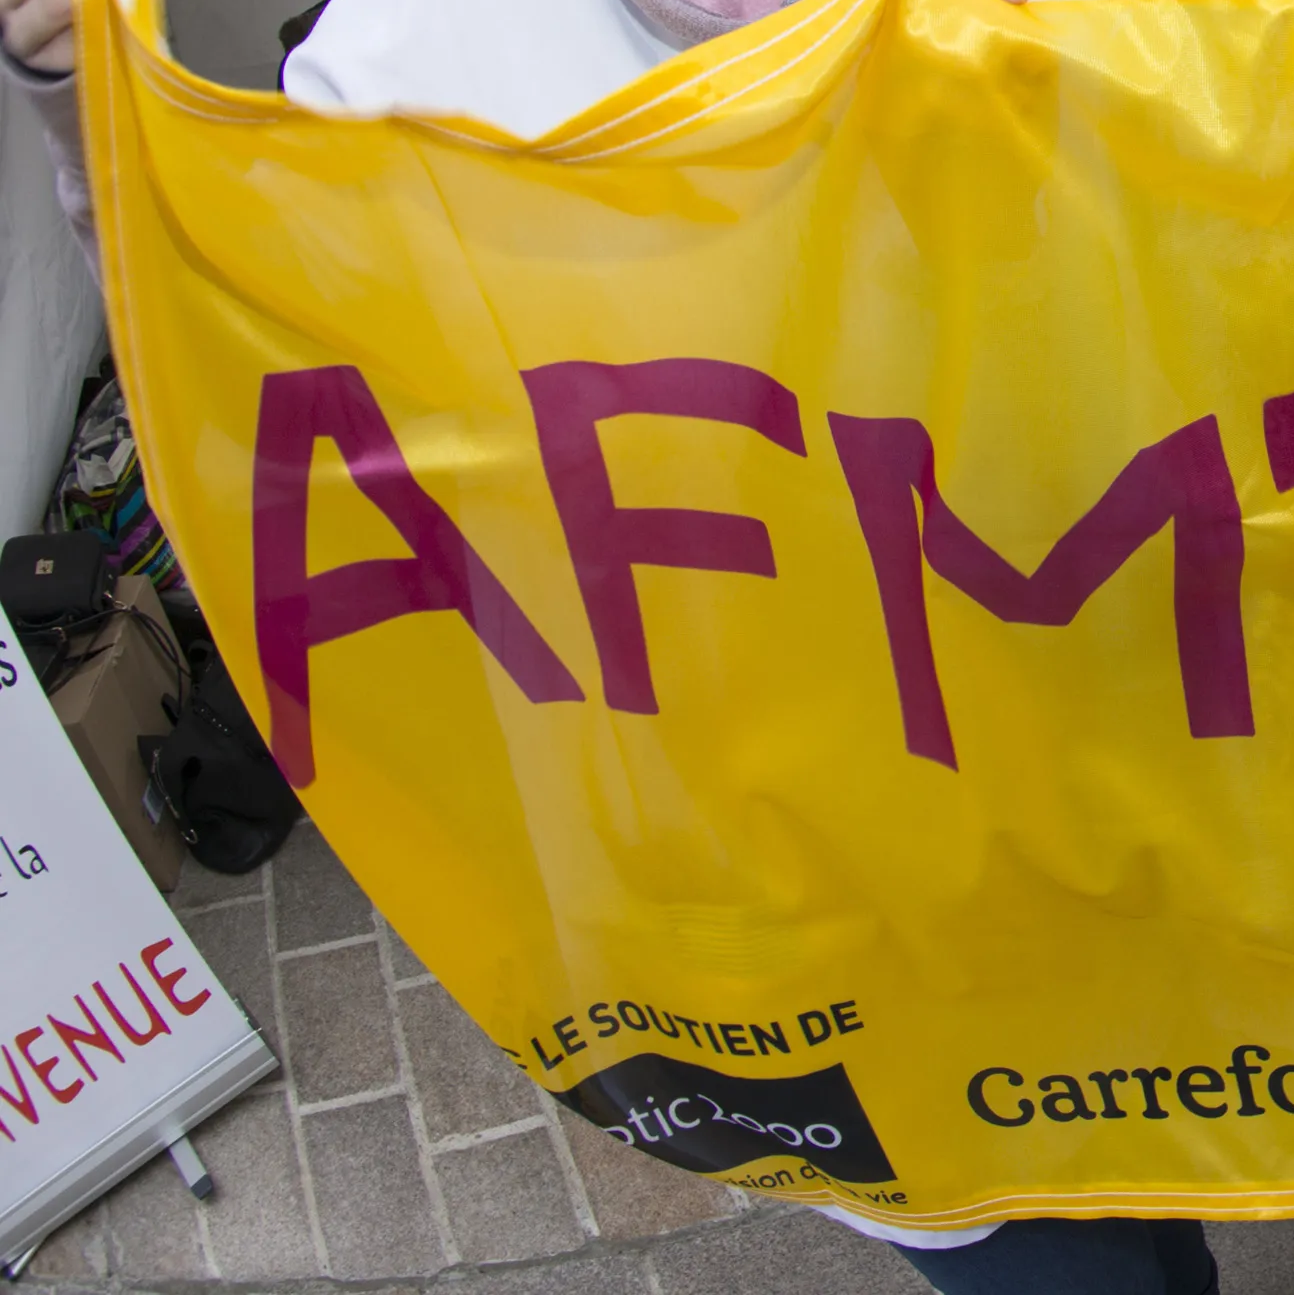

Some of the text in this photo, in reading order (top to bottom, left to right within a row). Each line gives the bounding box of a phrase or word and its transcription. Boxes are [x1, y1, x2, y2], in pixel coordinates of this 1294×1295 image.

[531, 1016, 587, 1071] LE
[588, 1000, 791, 1057] SOUTIEN
[797, 999, 864, 1047] DE
[865, 1189, 909, 1205] vie
